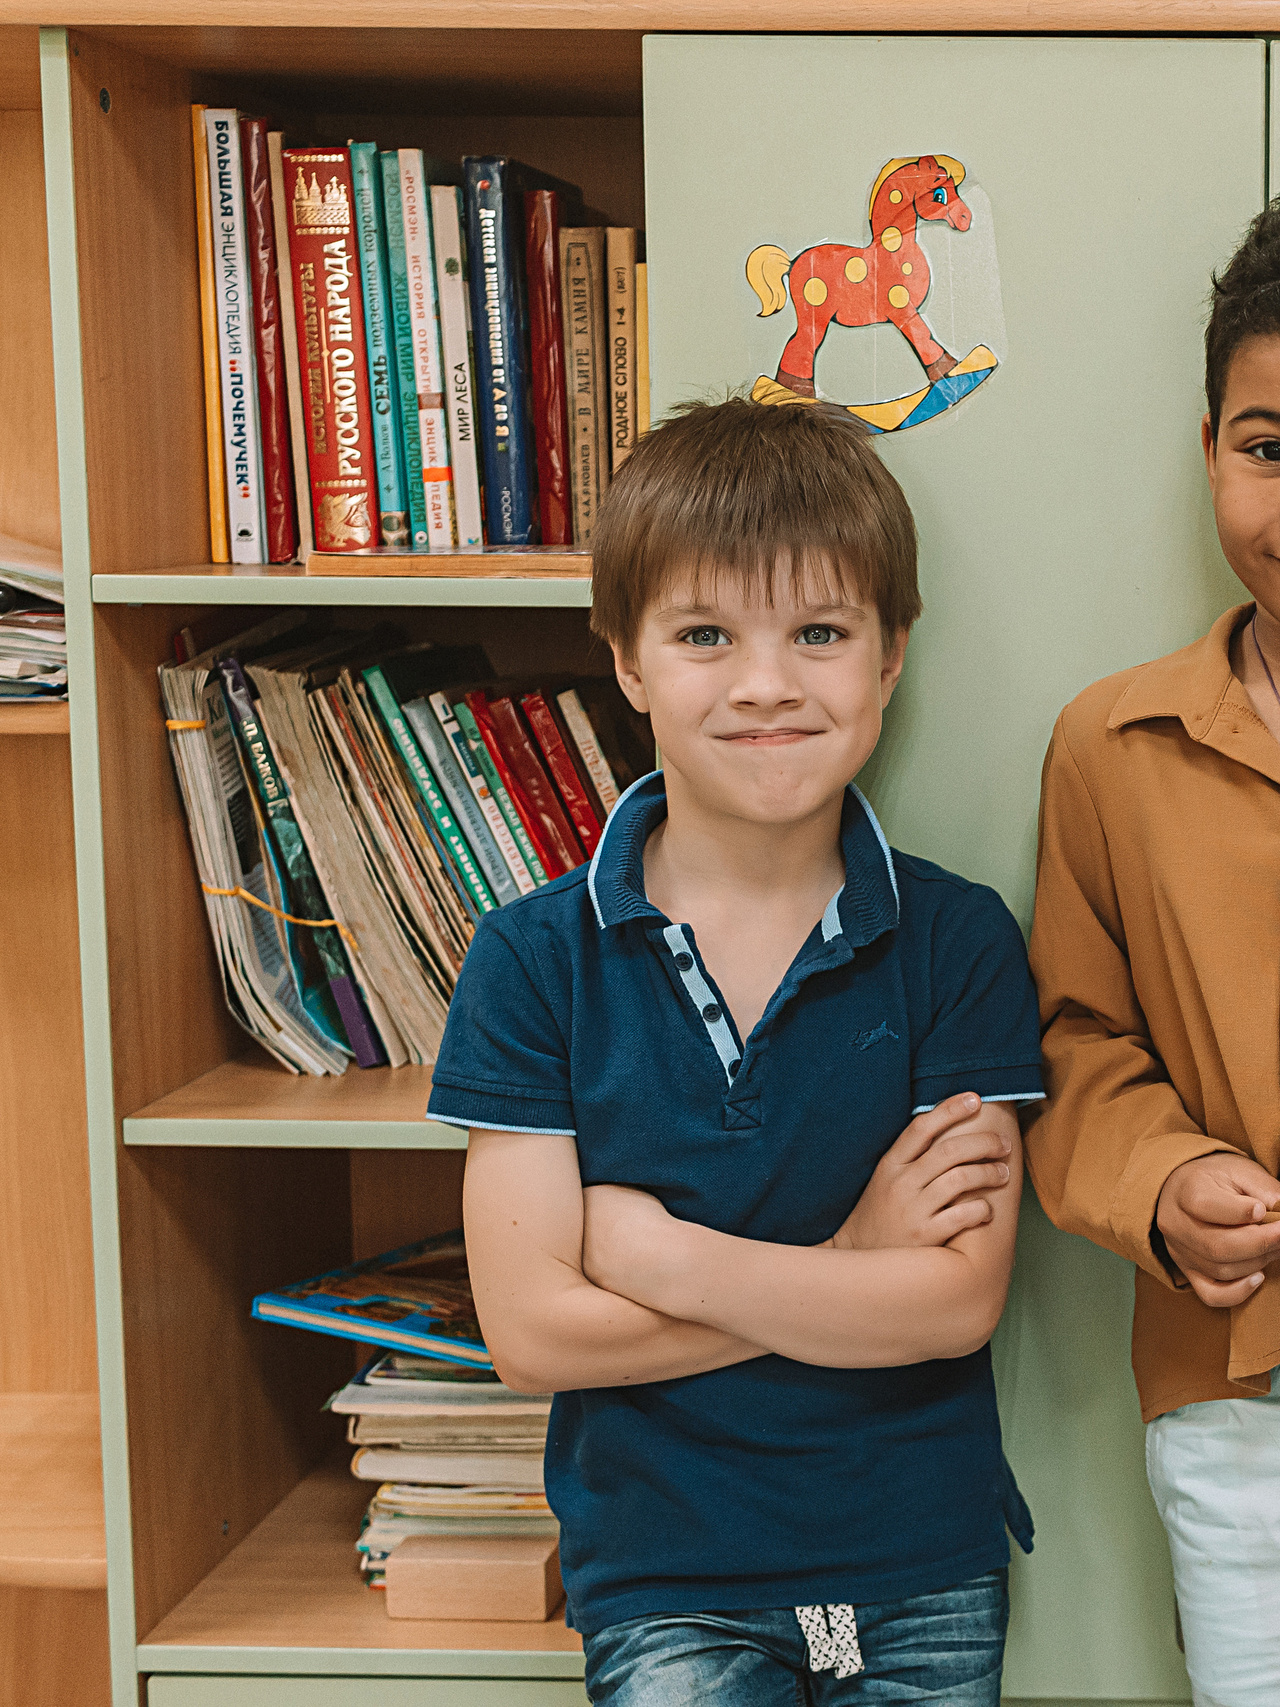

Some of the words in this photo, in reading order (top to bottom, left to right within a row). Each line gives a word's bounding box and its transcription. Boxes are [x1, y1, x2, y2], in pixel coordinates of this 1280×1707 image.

[214, 120, 233, 217] БОЛЬШАЯ
[355, 187, 377, 252] королей
[477, 207, 495, 264] Детская
[220, 221, 241, 355] ЭНЦИКЛОПЕДИЯ
[299, 262, 320, 361] КУЛЬТУРЫ
[322, 238, 354, 343] НАРОДА
[364, 261, 384, 347] подземных
[391, 274, 409, 340] ЖИВОЙ
[409, 255, 425, 319] ИСТОРИЯ
[480, 267, 504, 366] энциклопедия
[571, 276, 588, 334] КАМНЯ
[372, 355, 390, 415] СЕМЬ
[397, 343, 413, 381] МИР
[415, 329, 432, 395] ОТКРЫТИ
[453, 362, 468, 404] ЛЕСА
[575, 347, 590, 394] МИРЕ
[614, 336, 627, 385] СЛОВО
[308, 368, 325, 453] ИСТОРИЯ
[330, 347, 362, 476] РУССКОГО
[456, 406, 471, 441] МИР
[492, 387, 507, 400] А
[493, 403, 508, 420] до
[578, 406, 591, 415] В
[615, 391, 629, 448] РОДНОЕ
[401, 391, 426, 521] ЭНЦИКЛОПЕДИЯ
[495, 425, 509, 436] Я
[423, 418, 444, 529] ЭНЦИКПЕДИЯ
[391, 716, 443, 809] ЭРУДИЦИЮ
[440, 815, 451, 828] И
[496, 786, 521, 825] БЕЖАЛ
[514, 826, 536, 860] ЕЖИК
[530, 859, 544, 877] ПО
[449, 833, 493, 912] НТЕЛЛЕКТ
